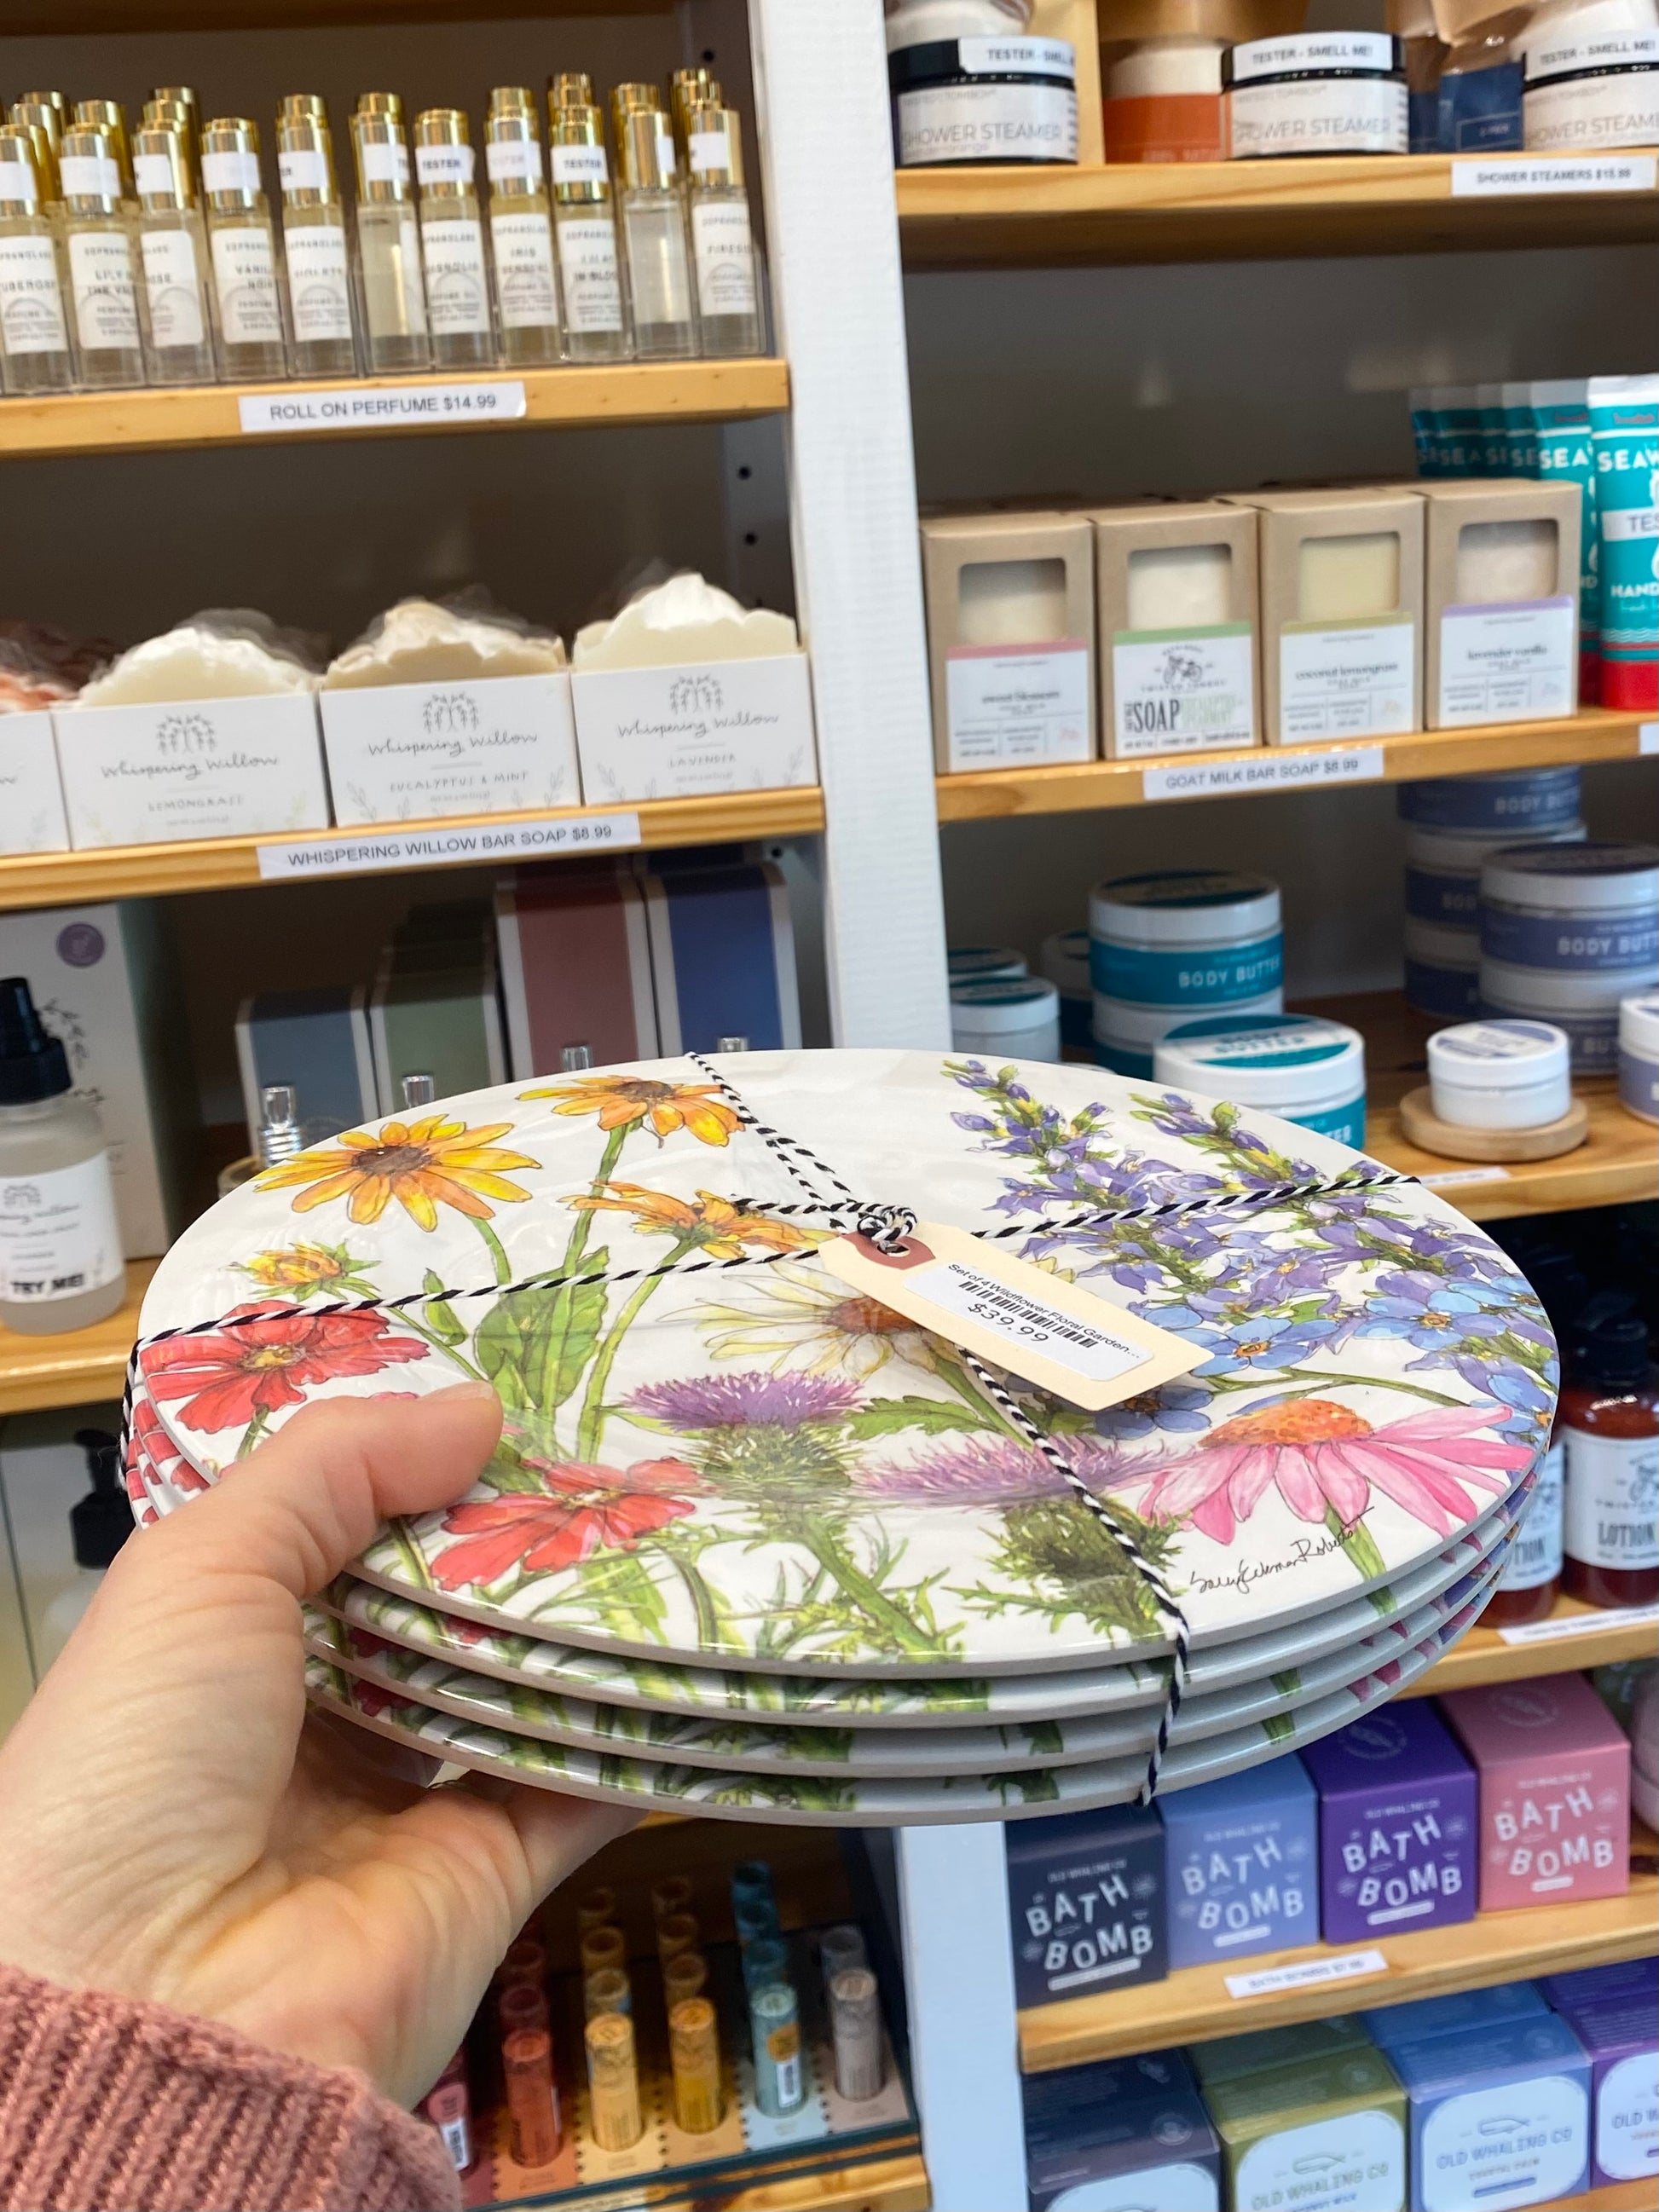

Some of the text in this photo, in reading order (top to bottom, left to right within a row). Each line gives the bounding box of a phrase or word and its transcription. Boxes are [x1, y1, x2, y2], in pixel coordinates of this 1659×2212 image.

[1252, 49, 1295, 64] TESTER
[1308, 43, 1348, 55] SMELL
[1587, 40, 1630, 57] SMELL
[1477, 170, 1528, 184] SHOWER
[1530, 169, 1593, 182] STEAMERS
[269, 394, 497, 420] ROLL ON PERFUME $14.99
[617, 712, 780, 740] Whispering Willow
[1133, 699, 1181, 733] SOAP
[367, 731, 539, 759] Whispering Willow
[668, 753, 737, 769] LAVENDER
[101, 750, 280, 782] Whispering Willow
[494, 770, 530, 783] MINT
[1166, 773, 1205, 789] GOAT
[1209, 771, 1242, 785] MILK
[1246, 768, 1277, 783] BAR
[1280, 762, 1320, 779] SOAP
[286, 844, 401, 868] WHISPERING
[404, 835, 478, 857] WILLOW
[481, 832, 517, 850] BAR
[518, 829, 568, 846] SOAP
[1558, 936, 1611, 956] BODY
[1177, 967, 1228, 989] BODY
[948, 1262, 1142, 1360] Set of 4 Wildflower Floral Garden...
[968, 1302, 1049, 1343] $39.99
[1598, 1521, 1656, 1547] LOTION
[1493, 1786, 1593, 1841] BATH
[1341, 1812, 1442, 1874] BATH
[1508, 1834, 1614, 1876] BOMB
[1181, 1835, 1283, 1897] BATH
[1356, 1863, 1462, 1908] BOMB
[1026, 1872, 1130, 1938] BATH
[1197, 1885, 1304, 1931] BOMB
[1043, 1921, 1154, 1972] BOMB
[1436, 2146, 1468, 2170] OLD
[1470, 2133, 1547, 2163] WHALING
[1286, 2169, 1364, 2202] WHALING
